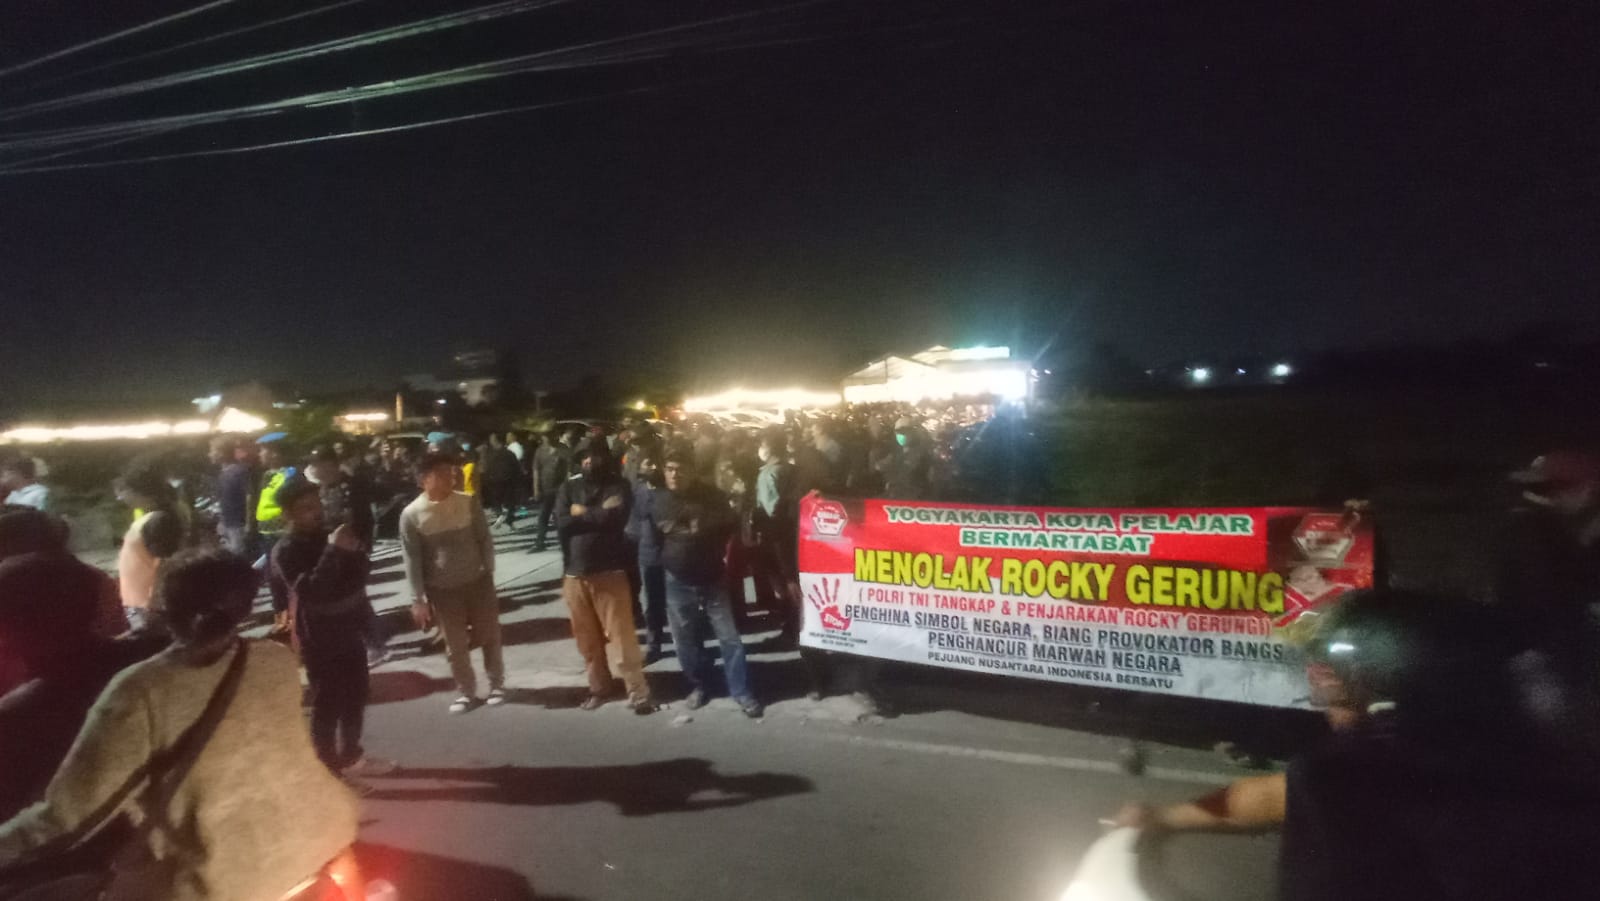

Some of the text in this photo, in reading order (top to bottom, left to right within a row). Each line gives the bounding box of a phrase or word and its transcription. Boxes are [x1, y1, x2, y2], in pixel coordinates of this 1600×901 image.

[887, 506, 1251, 533] YOGYAKARTA KOTA PELAJAR
[962, 530, 1151, 552] BERMARTABAT
[854, 548, 1285, 614] MENOLAK ROCKY GERUNG
[867, 588, 904, 604] POLRI
[909, 591, 929, 607] TNI
[933, 594, 995, 613] TANGKAP
[1001, 601, 1012, 615] &
[1017, 602, 1118, 624] PENJARAKAN
[1124, 610, 1181, 629] ROCKY
[845, 604, 910, 624] PENGHINA
[914, 611, 969, 631] SIMBOL
[1043, 624, 1091, 643] BIANG
[1098, 630, 1214, 654] PROVOKATOR
[1221, 639, 1293, 661] BANGS
[928, 631, 1181, 673] PENGHANCUR MARWAH NEGARA
[928, 651, 1173, 689] PEJUANG NUSANTARA INDONESIA BERSATU
